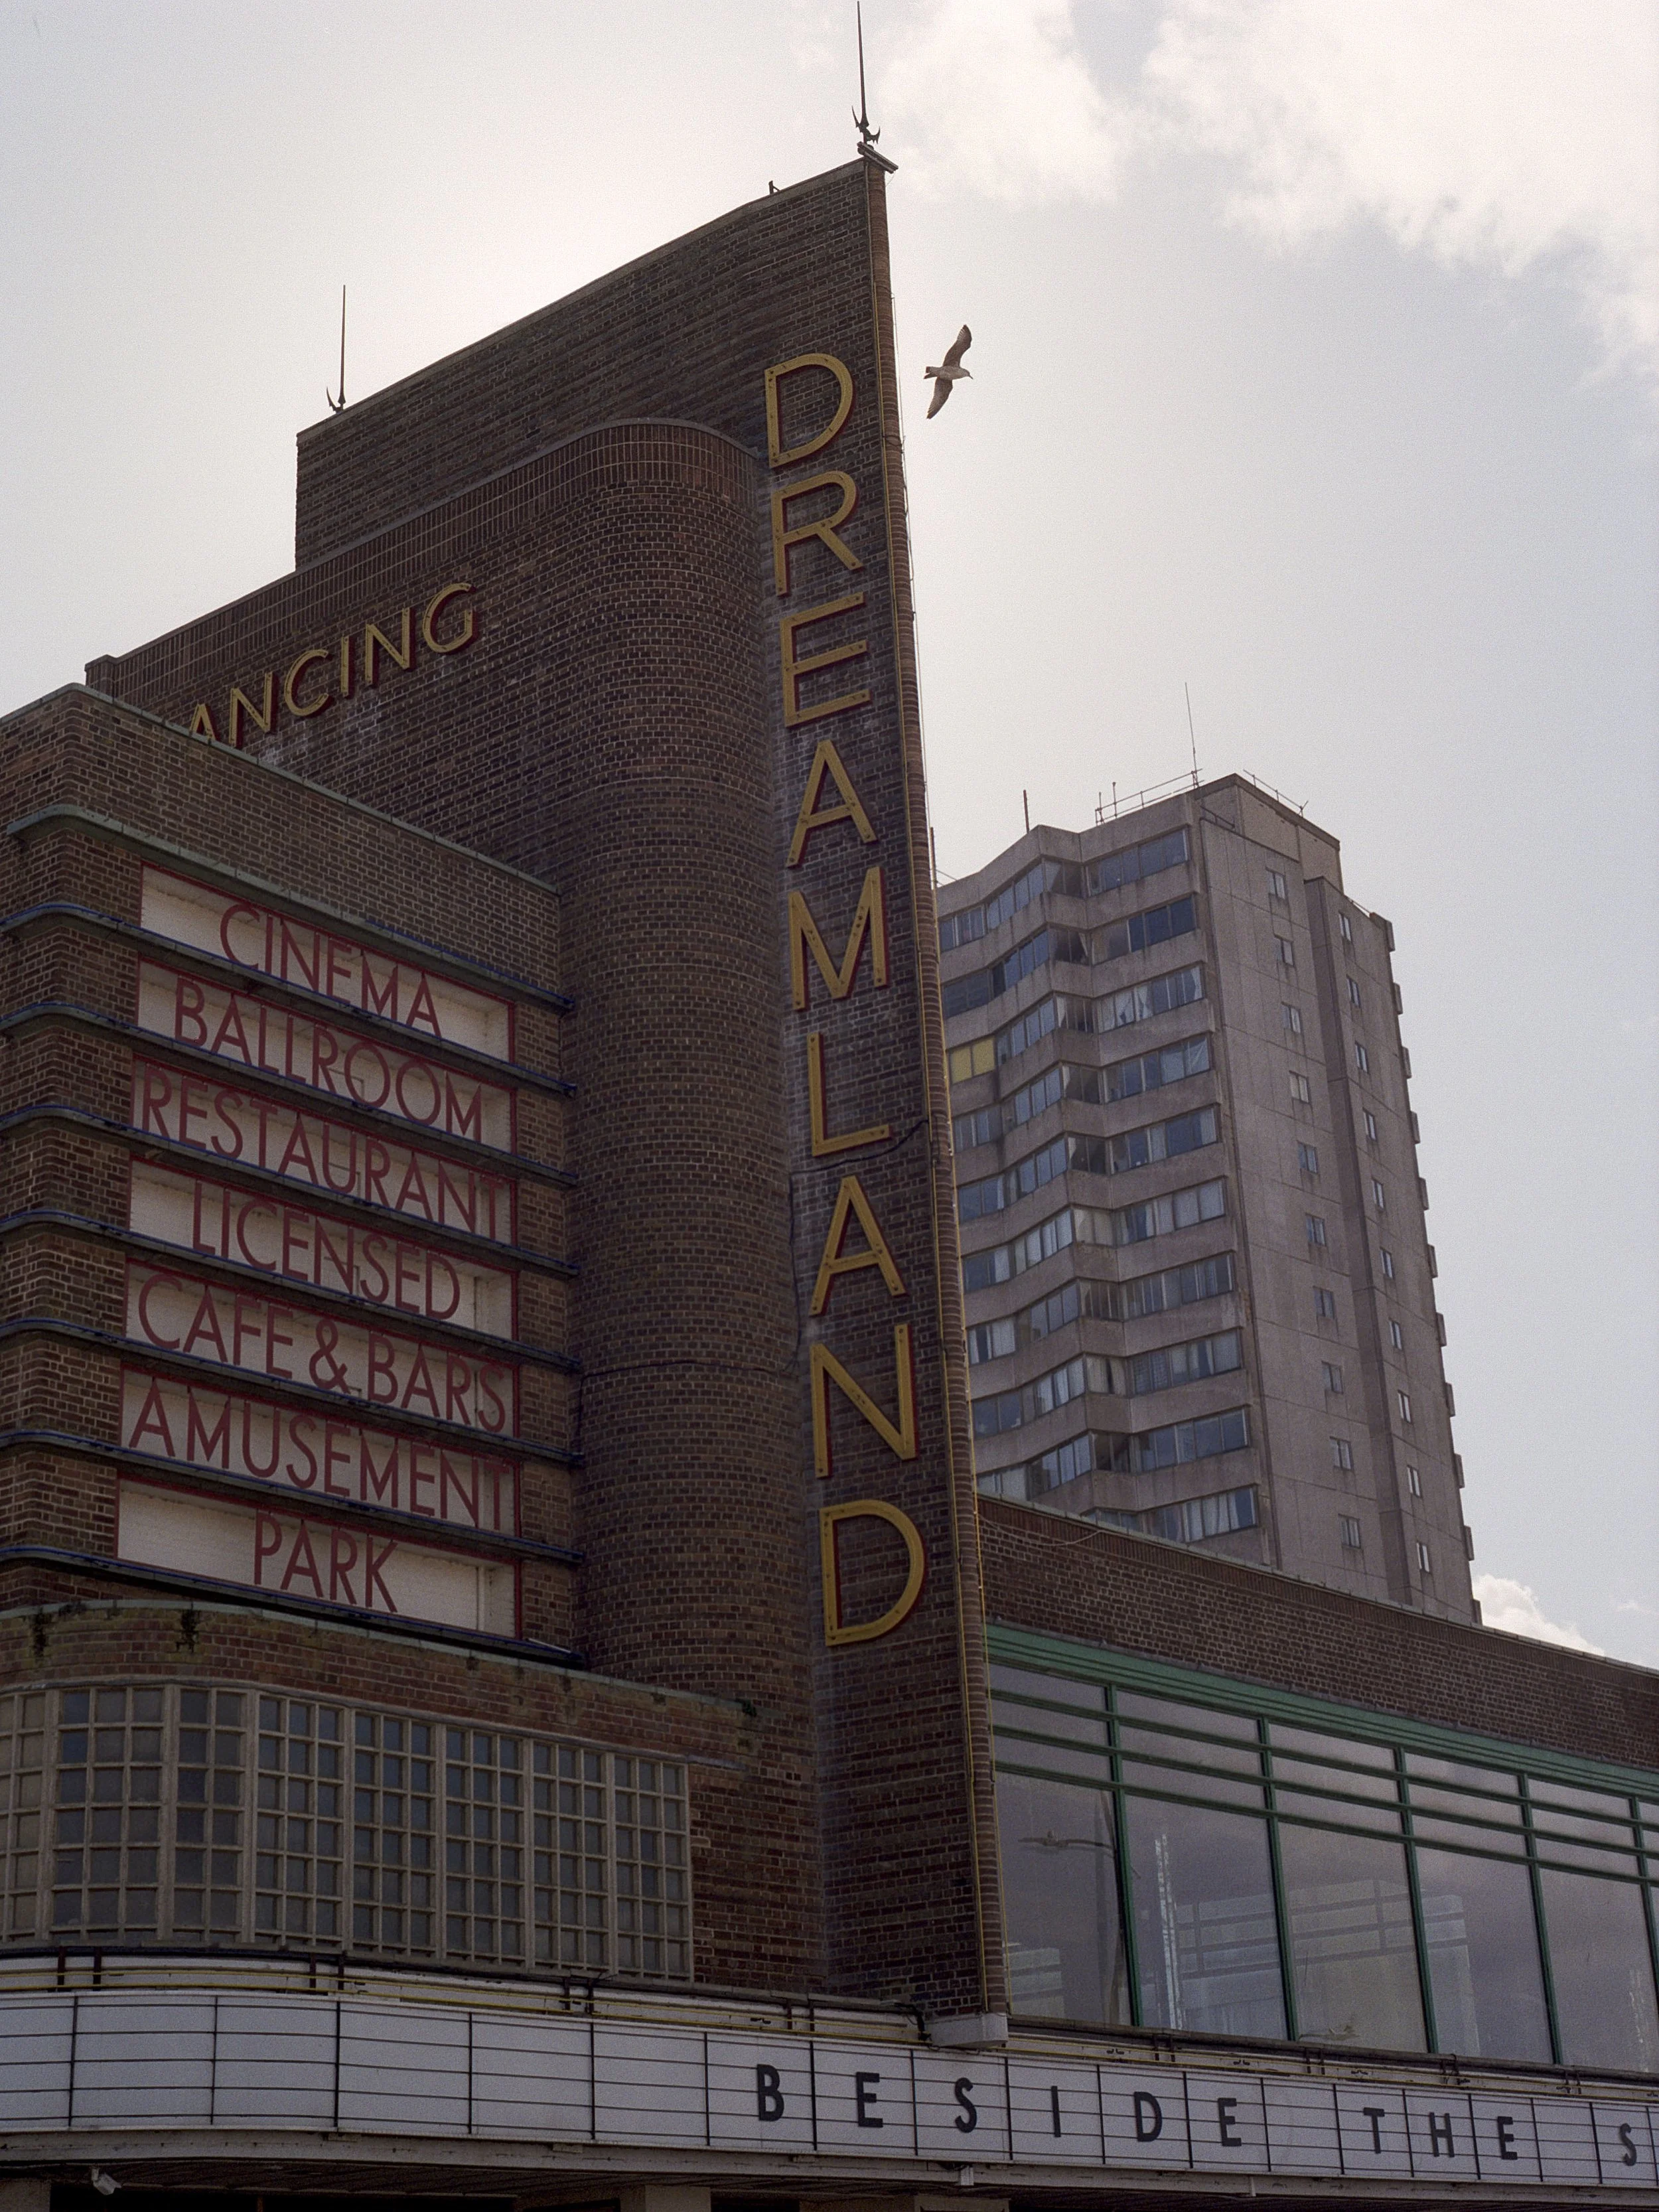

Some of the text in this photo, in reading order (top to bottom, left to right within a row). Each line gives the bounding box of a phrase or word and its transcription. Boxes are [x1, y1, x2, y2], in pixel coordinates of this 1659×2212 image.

[220, 903, 443, 1039] CINEMA
[764, 353, 924, 1647] DREAMLAND
[175, 976, 482, 1142] BALLROOM
[141, 1063, 509, 1240] RESTAURANT
[193, 1179, 461, 1320] LICENSED
[129, 1376, 510, 1530] AMUSEMENT
[254, 1510, 397, 1613] PARK
[756, 2064, 1242, 2146] BESIDE
[1364, 2107, 1518, 2160] THE
